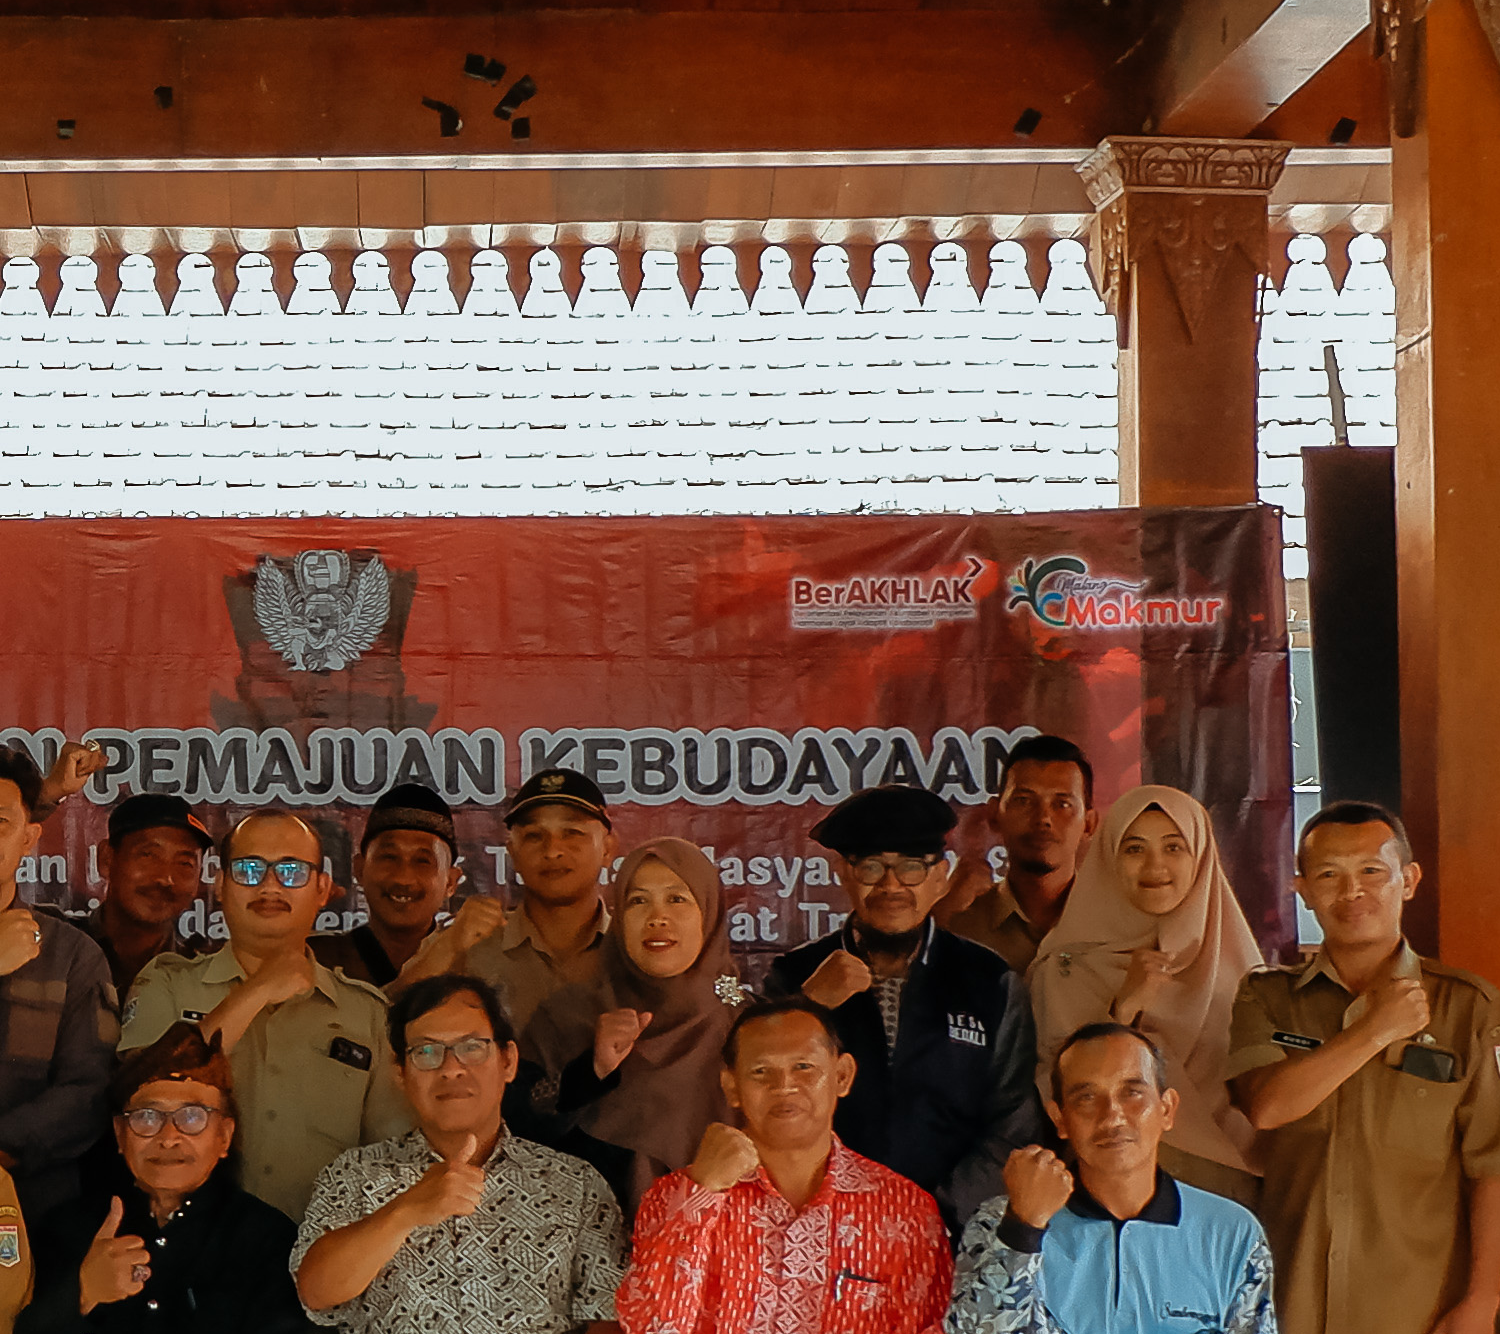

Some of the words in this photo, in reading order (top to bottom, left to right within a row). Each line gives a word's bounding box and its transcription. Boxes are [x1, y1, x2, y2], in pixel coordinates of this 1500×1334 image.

[793, 579, 973, 605] BerAKHLAK
[1066, 593, 1223, 626] Makmur
[88, 728, 503, 804] PEMAJUAN
